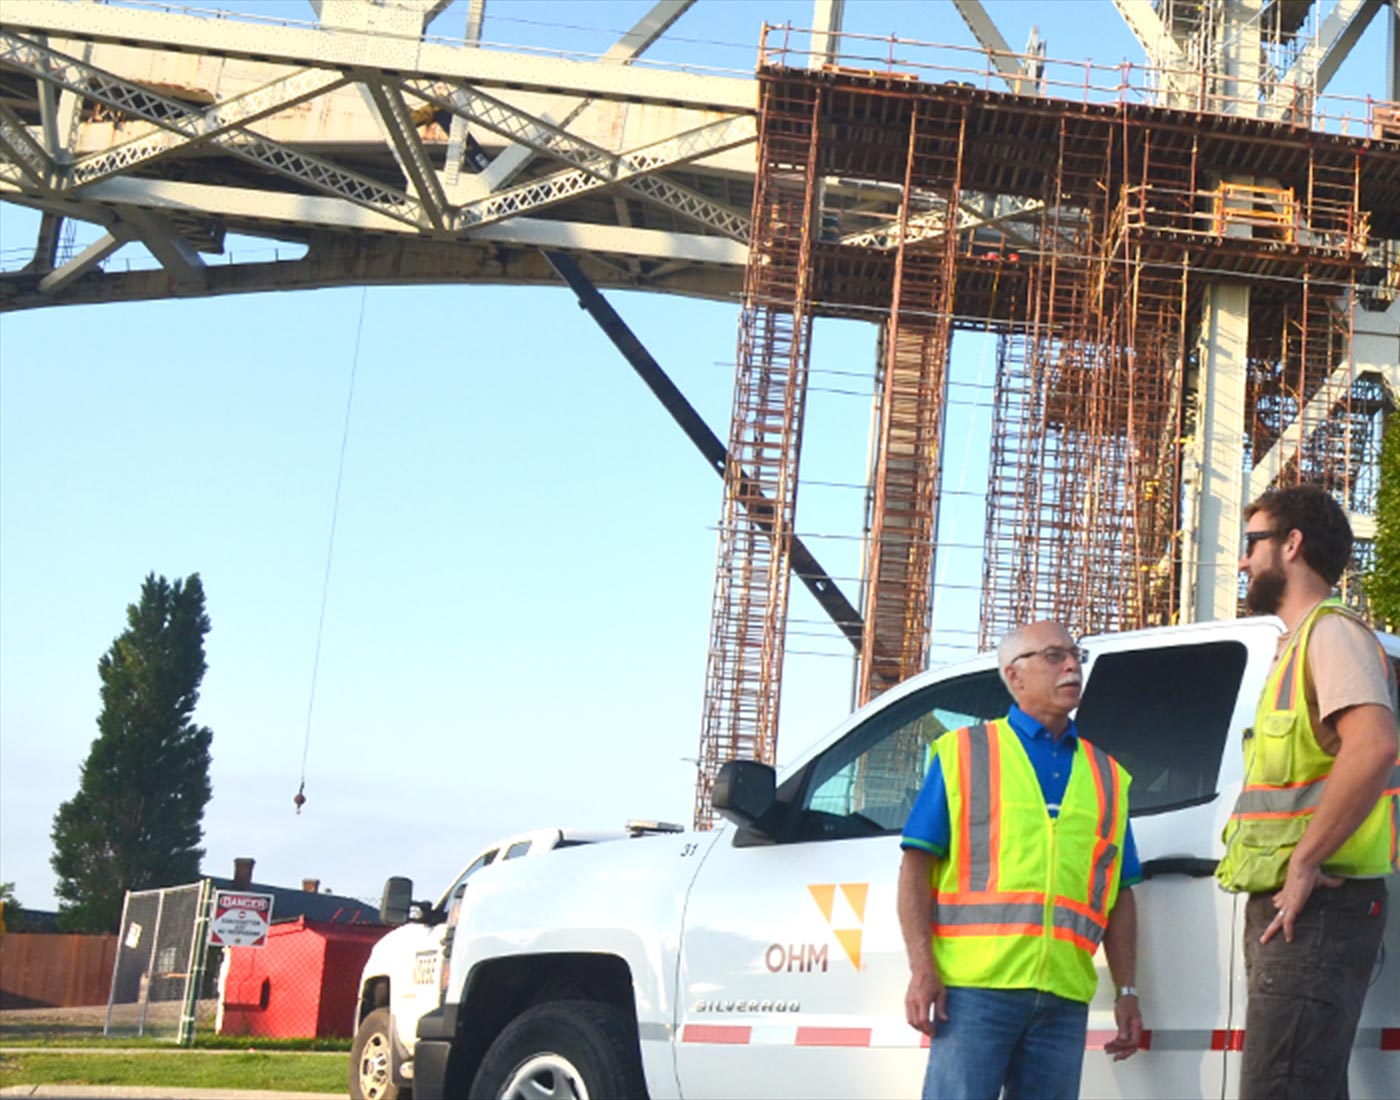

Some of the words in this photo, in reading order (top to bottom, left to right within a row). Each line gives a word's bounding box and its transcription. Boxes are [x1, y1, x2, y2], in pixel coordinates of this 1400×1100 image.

[680, 843, 699, 857] 31
[220, 896, 268, 911] DANGER
[765, 942, 829, 973] OHM
